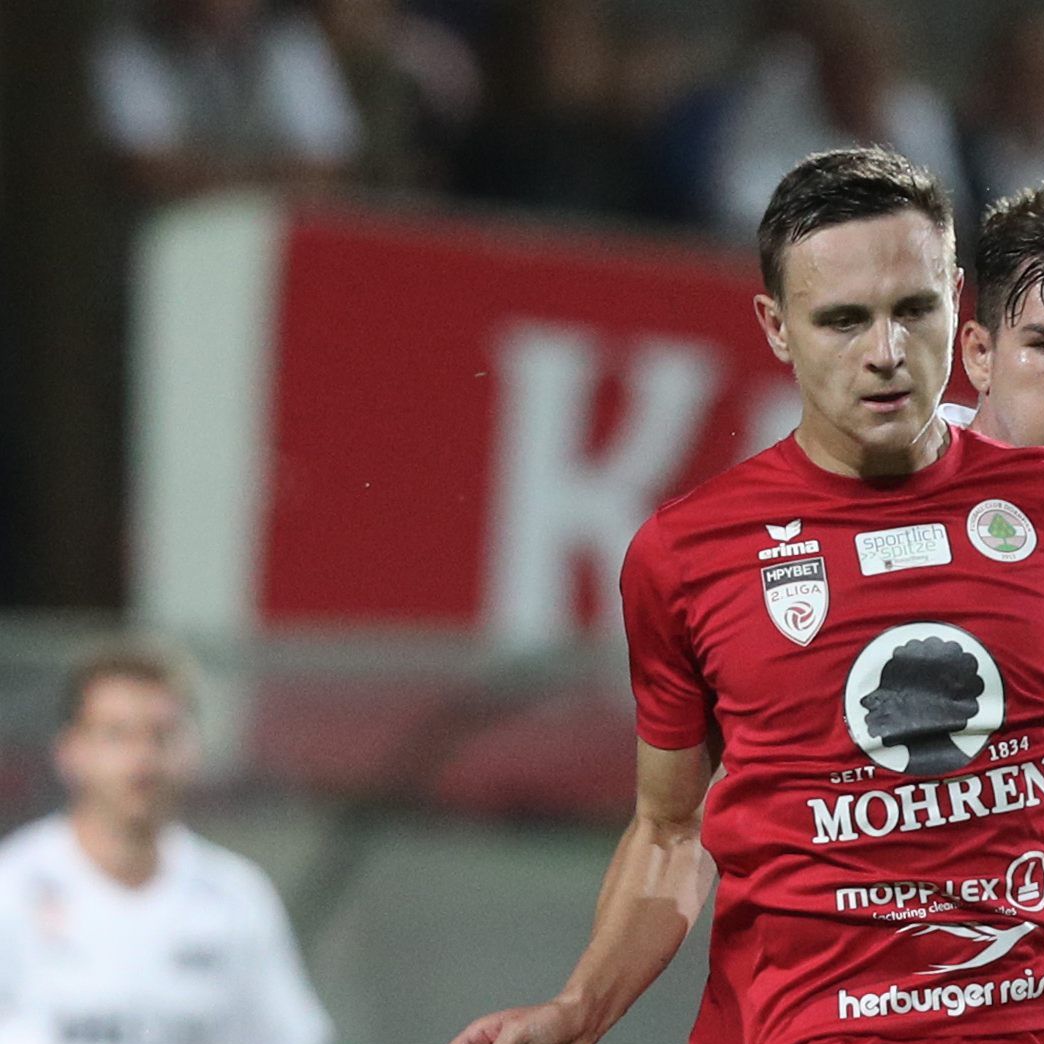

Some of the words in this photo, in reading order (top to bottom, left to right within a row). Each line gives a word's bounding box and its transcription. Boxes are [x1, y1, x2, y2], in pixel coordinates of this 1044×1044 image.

[863, 525, 944, 552] sportlich
[758, 540, 820, 560] erima
[766, 562, 820, 583] HPYBET
[786, 584, 822, 597] LIGA
[988, 736, 1029, 761] 1834
[830, 765, 876, 783] SEIT
[838, 982, 995, 1020] herburger
